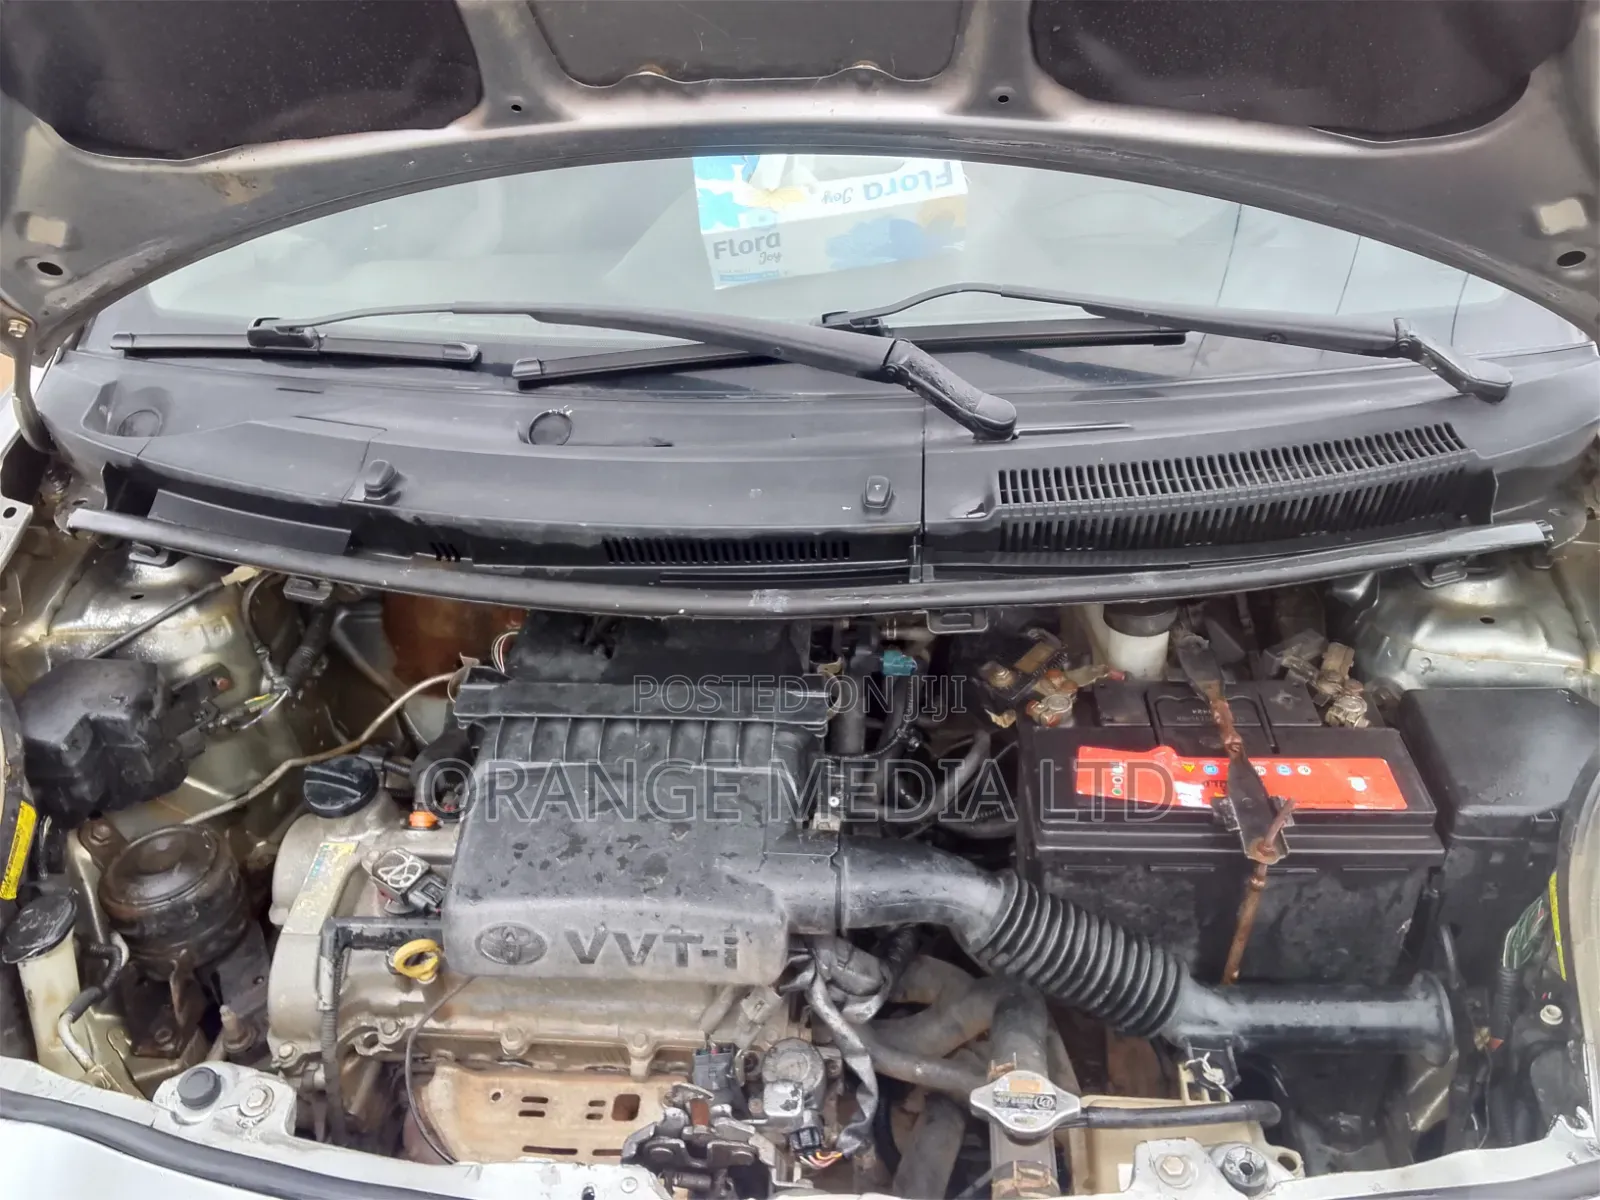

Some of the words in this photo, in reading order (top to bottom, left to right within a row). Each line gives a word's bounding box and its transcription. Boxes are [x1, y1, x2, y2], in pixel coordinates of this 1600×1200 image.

[863, 161, 953, 201] Flora
[821, 187, 853, 204] Joy
[713, 232, 781, 260] Flora
[759, 251, 783, 265] Joy
[564, 926, 738, 969] VVT-i
